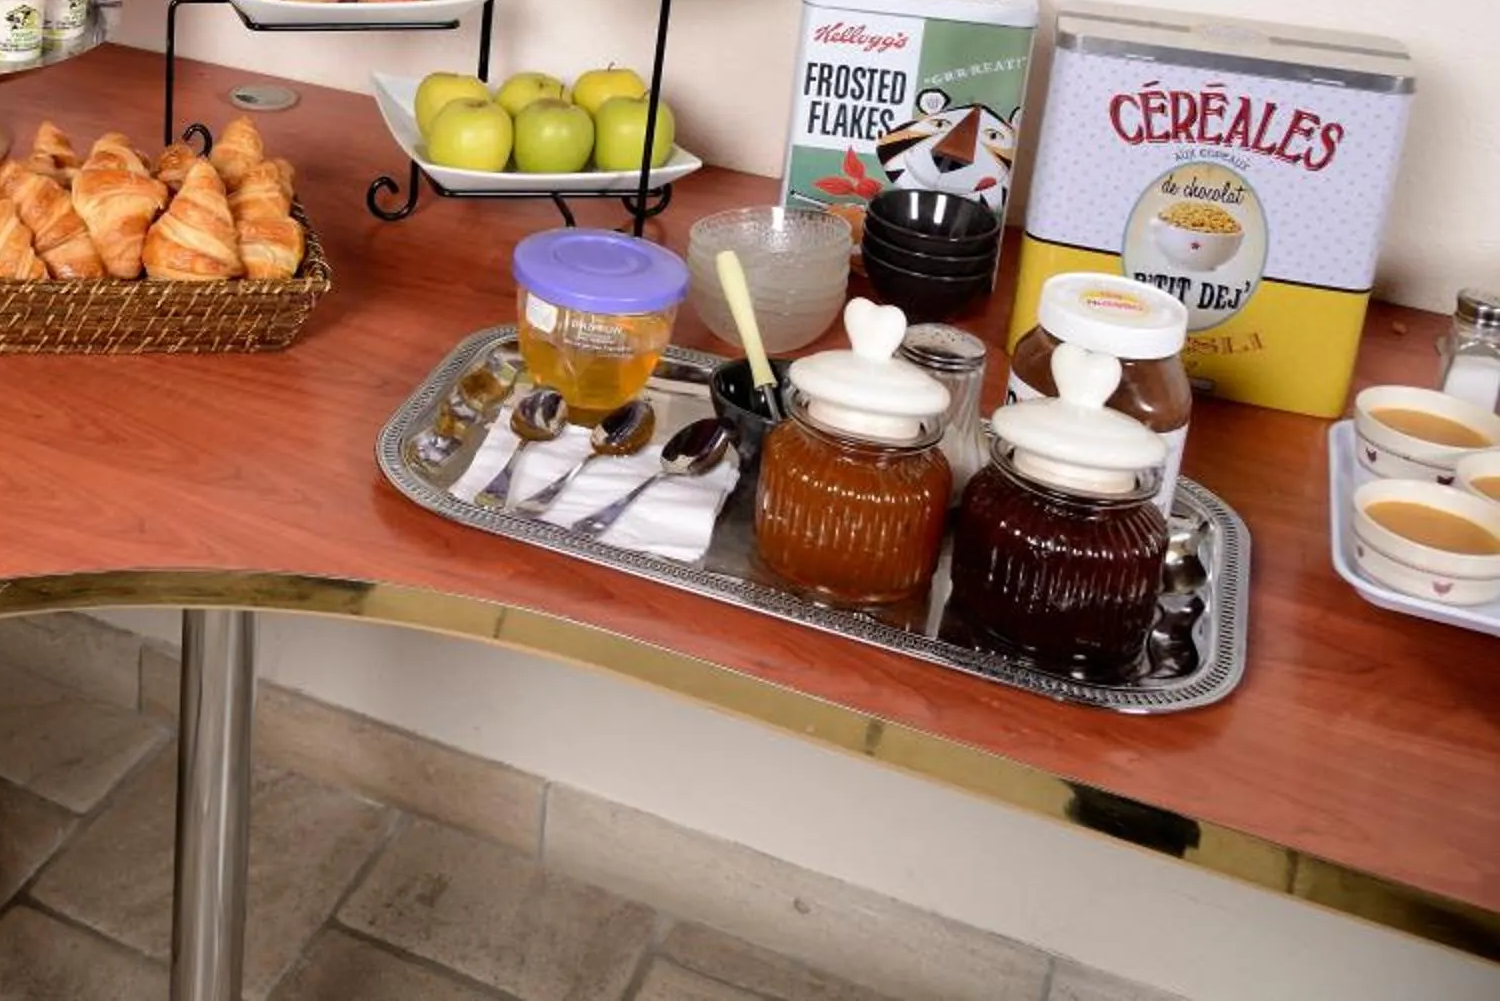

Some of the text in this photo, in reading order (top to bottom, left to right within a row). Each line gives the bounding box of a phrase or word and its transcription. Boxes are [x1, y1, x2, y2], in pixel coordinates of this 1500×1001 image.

[813, 22, 909, 52] Kellogg's
[804, 62, 906, 105] FROSTED
[808, 101, 894, 140] FLAKES
[1109, 81, 1345, 172] CÉRÉALES
[1162, 174, 1245, 204] de chocolat
